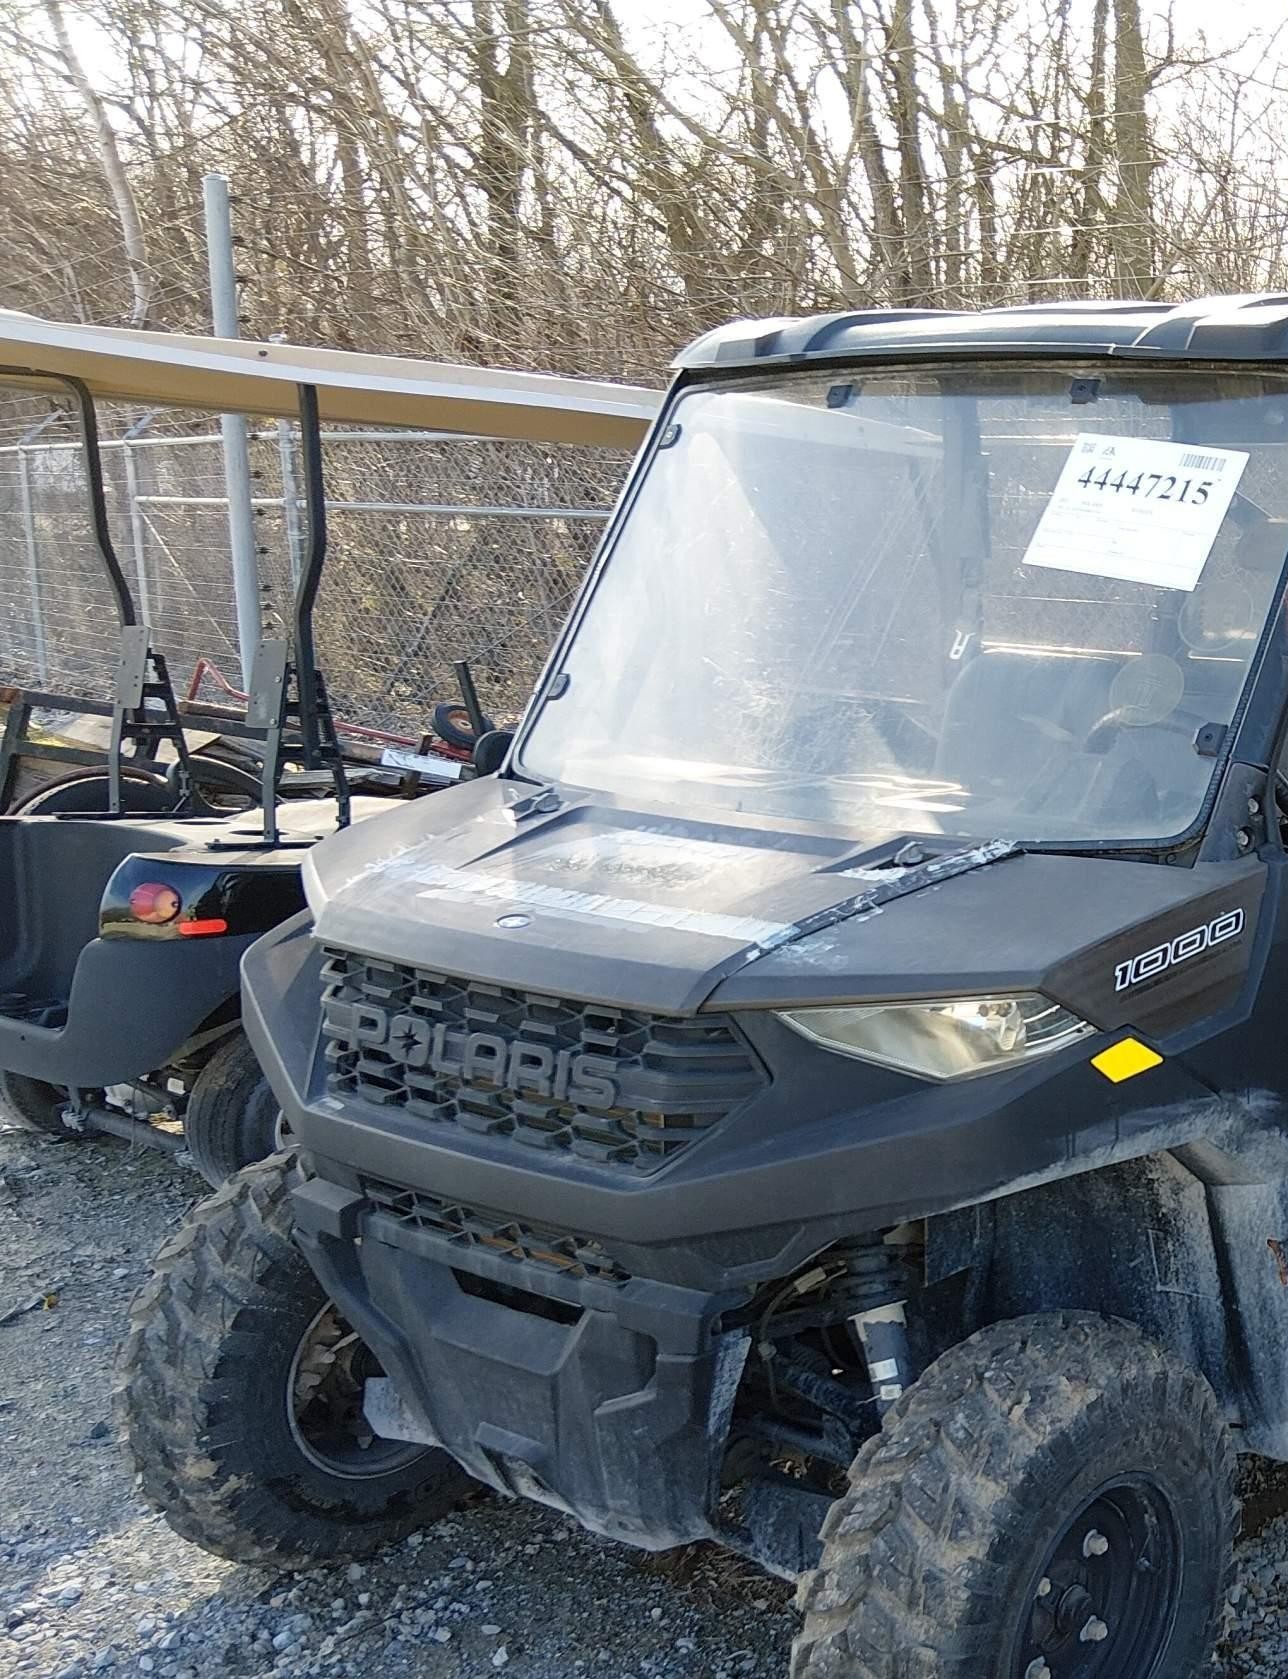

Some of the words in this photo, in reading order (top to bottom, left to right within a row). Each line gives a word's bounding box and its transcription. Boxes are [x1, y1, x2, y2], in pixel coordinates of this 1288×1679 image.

[1077, 466, 1213, 505] 44447215
[1114, 908, 1245, 992] 1000
[351, 1002, 620, 1110] POLARIS
